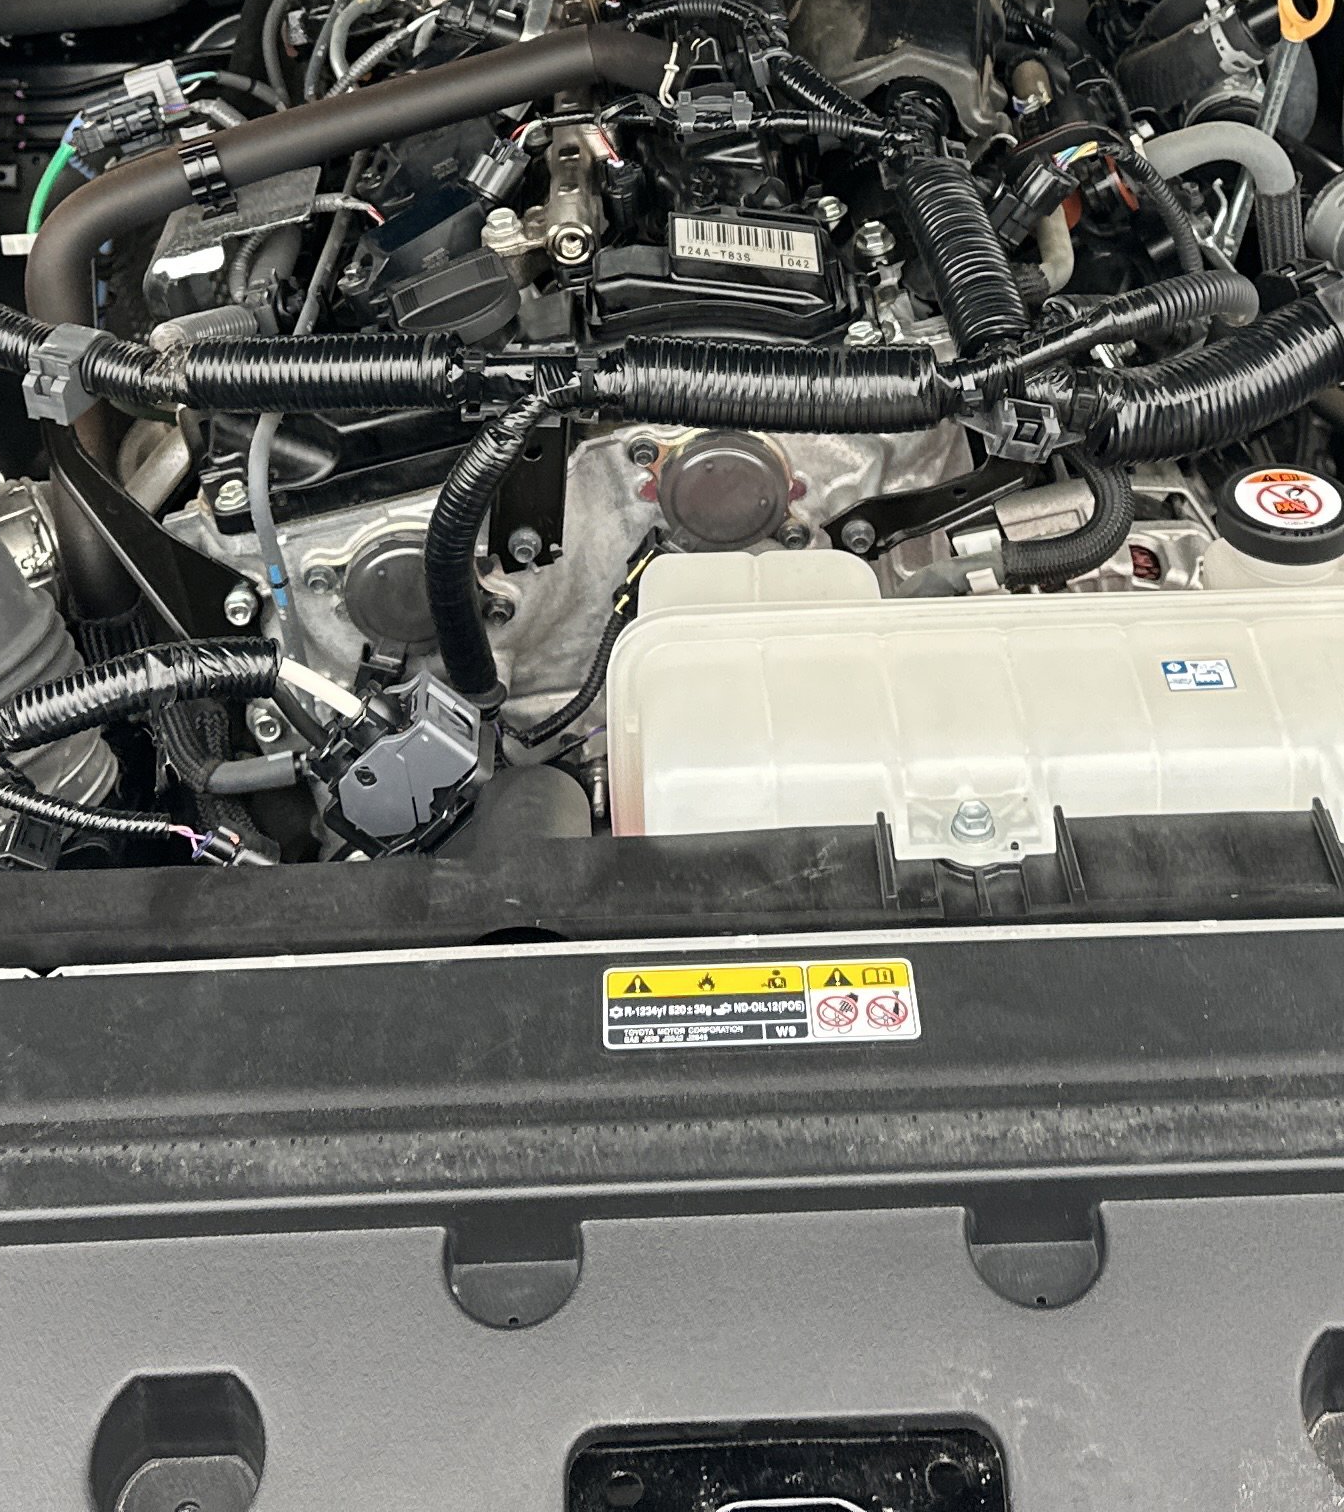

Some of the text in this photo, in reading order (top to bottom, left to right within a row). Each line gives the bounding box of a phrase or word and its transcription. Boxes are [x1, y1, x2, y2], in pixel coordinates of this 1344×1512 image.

[787, 259, 810, 269] 042
[623, 1025, 743, 1036] TOYOTA MOTOR CORPORATION
